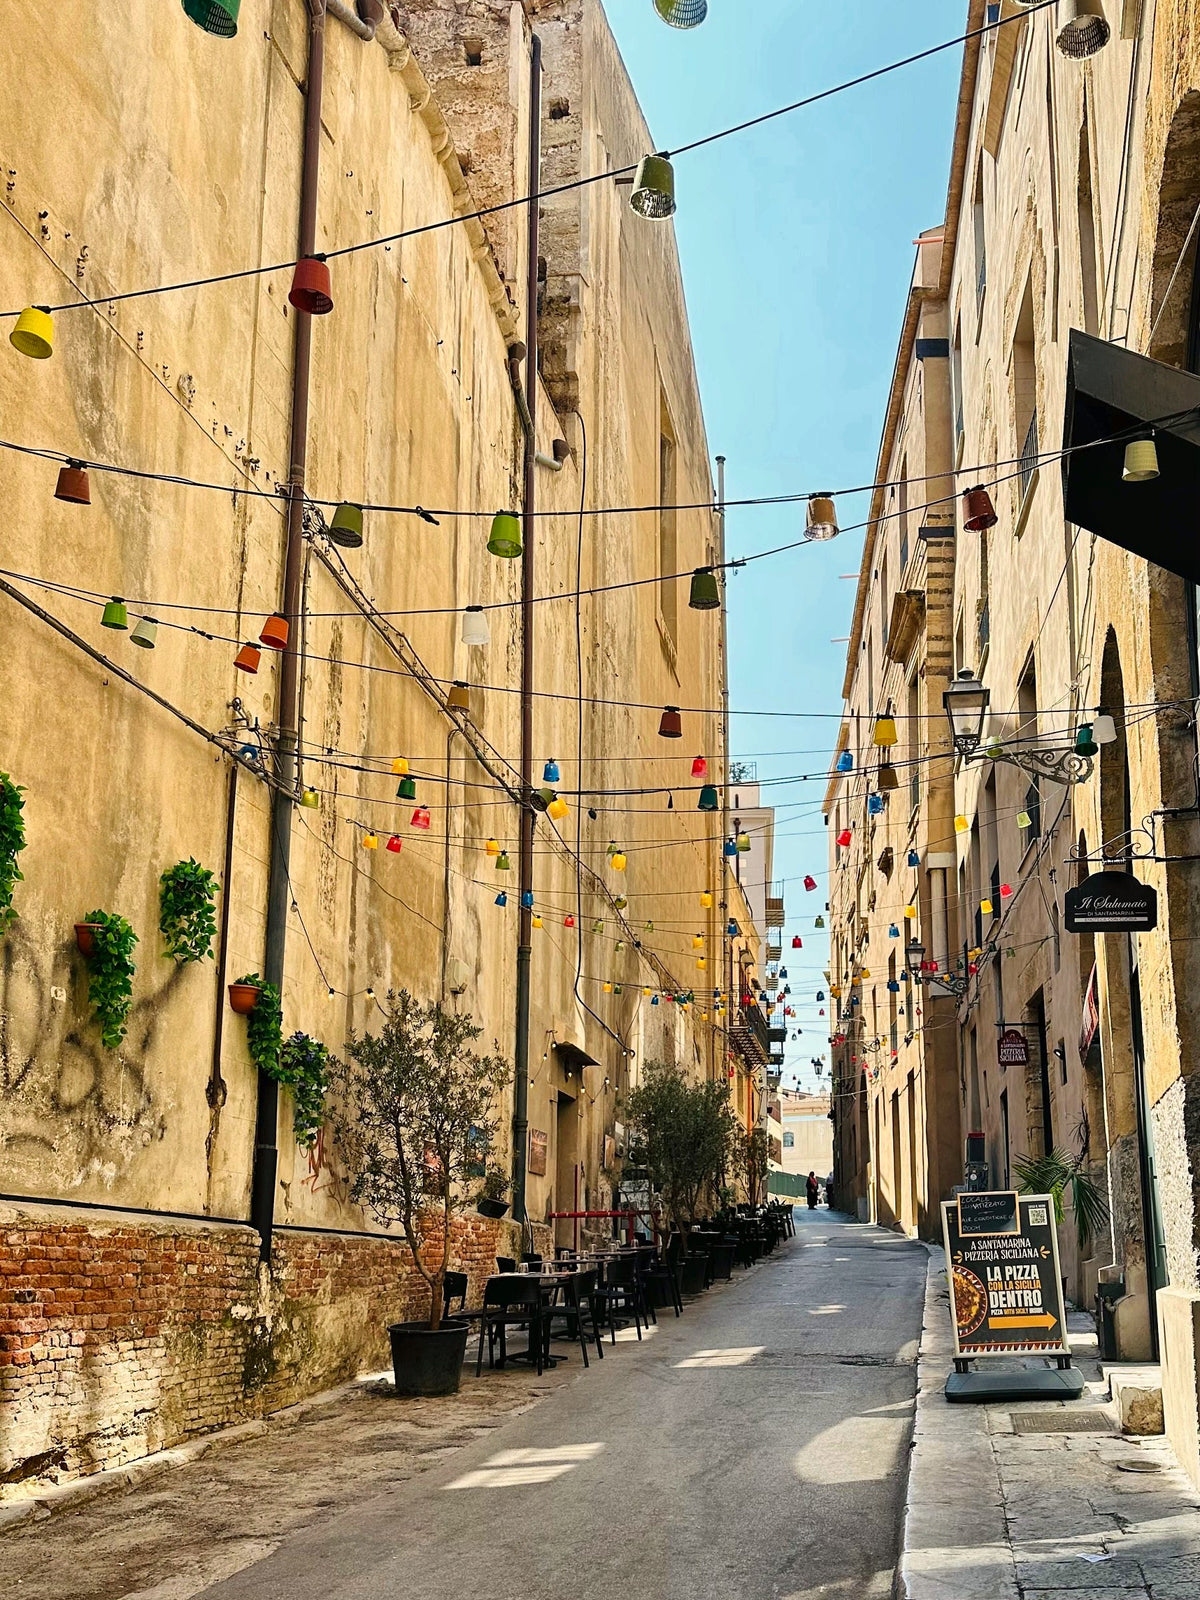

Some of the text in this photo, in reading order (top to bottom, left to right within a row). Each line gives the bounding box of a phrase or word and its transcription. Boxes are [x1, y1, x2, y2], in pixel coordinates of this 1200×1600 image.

[1074, 895, 1147, 910] Il Salumaio
[999, 1054, 1027, 1062] SICILIANA
[961, 1196, 990, 1204] LOCALE
[970, 1238, 1031, 1250] A SANTAMARINA
[964, 1248, 1039, 1261] PIZZERIA SICILIANA
[986, 1264, 1040, 1281] LA PIZZA
[988, 1280, 1042, 1291] CON LA SICILIA
[989, 1289, 1042, 1309] DENTRO
[990, 1308, 1004, 1316] PIZZA
